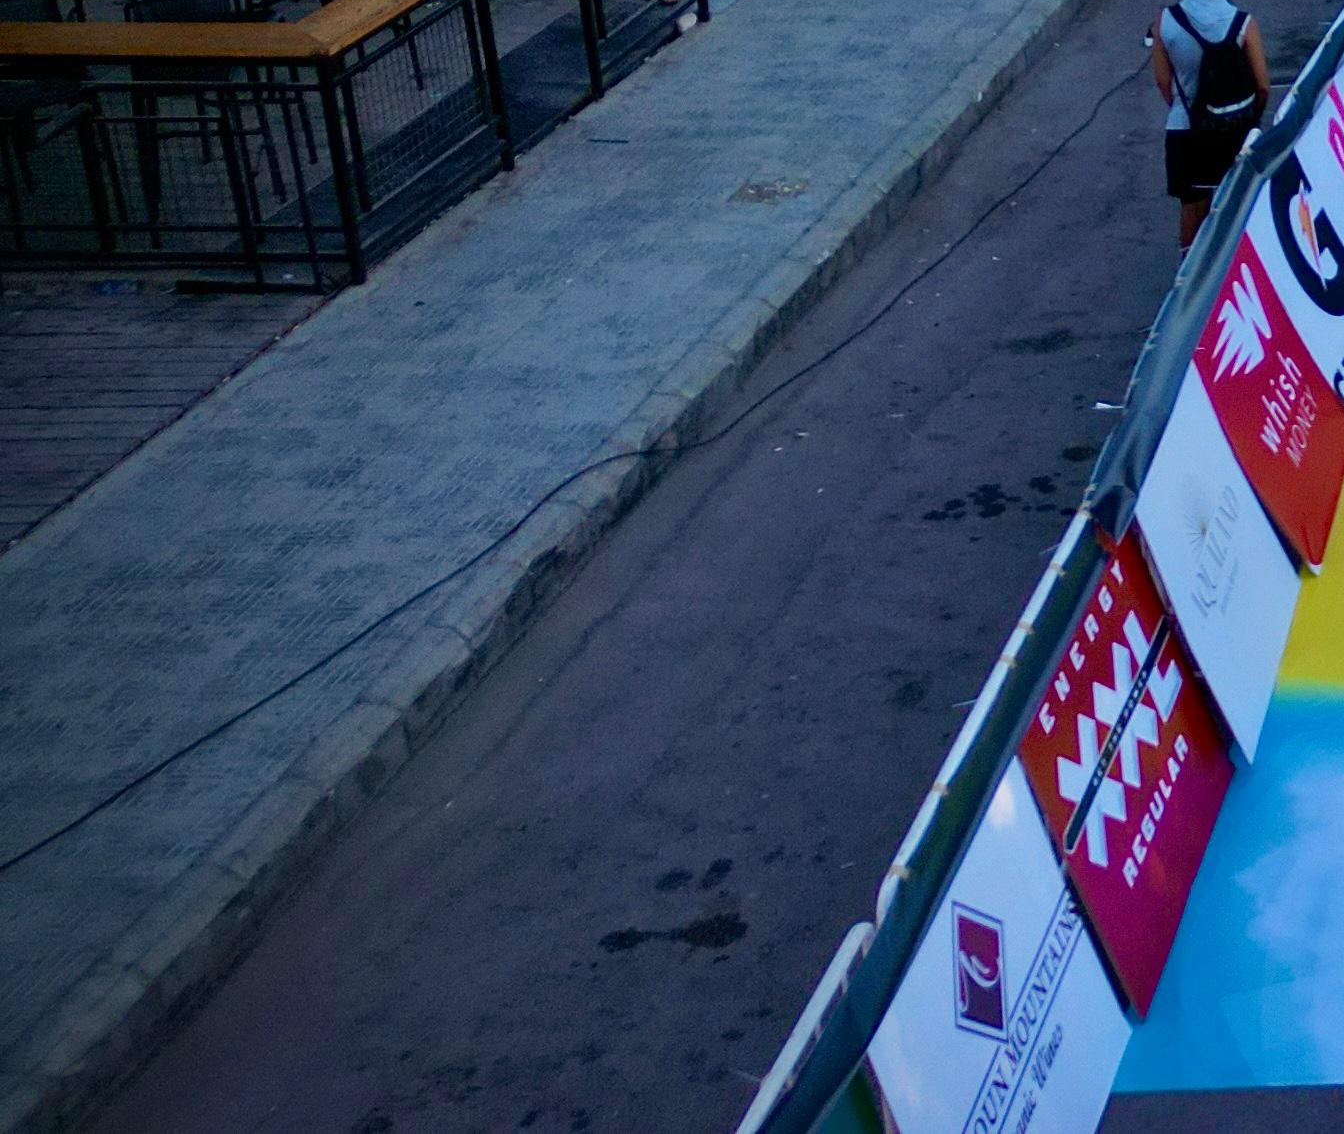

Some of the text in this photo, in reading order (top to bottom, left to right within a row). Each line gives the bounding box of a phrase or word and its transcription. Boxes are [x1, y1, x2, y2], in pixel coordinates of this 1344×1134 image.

[1259, 351, 1303, 455] whish
[1286, 385, 1319, 467] MONEY
[1038, 557, 1127, 736] ENERGY
[1057, 609, 1184, 867] XXL
[1121, 732, 1190, 889] REGULAR
[1033, 1024, 1064, 1087] Wines
